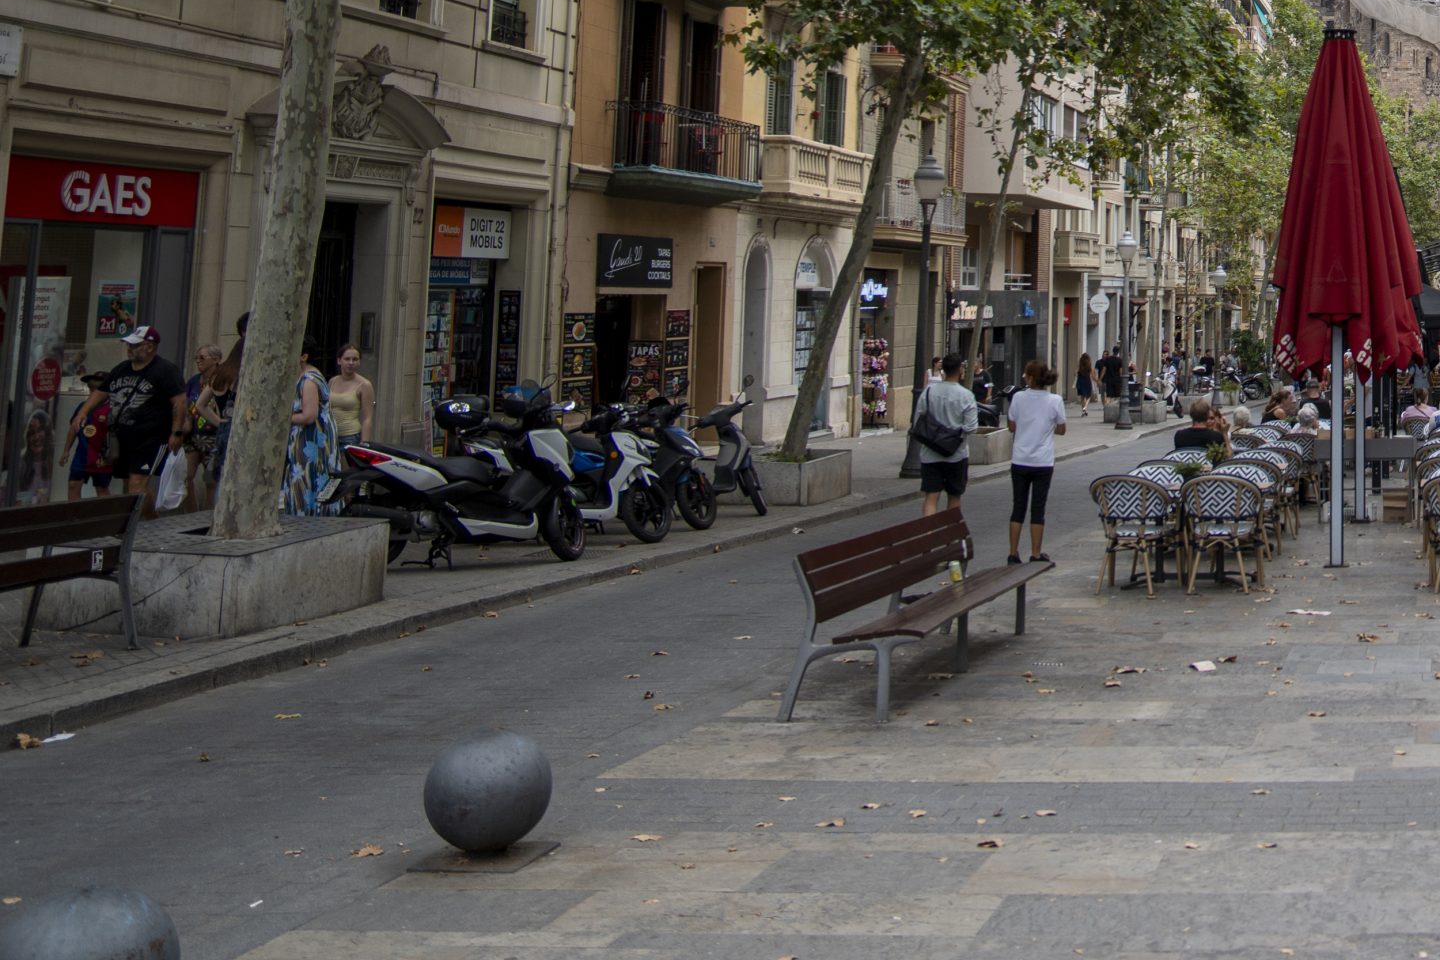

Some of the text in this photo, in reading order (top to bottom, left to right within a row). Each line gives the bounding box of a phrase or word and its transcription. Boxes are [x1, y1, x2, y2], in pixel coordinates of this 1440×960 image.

[61, 170, 152, 217] GAES
[470, 218, 505, 233] DIGIT 22
[470, 234, 504, 250] MOBILS
[651, 259, 671, 269] BURGERS
[647, 271, 671, 280] COCKTAILS
[100, 317, 116, 330] 2x1
